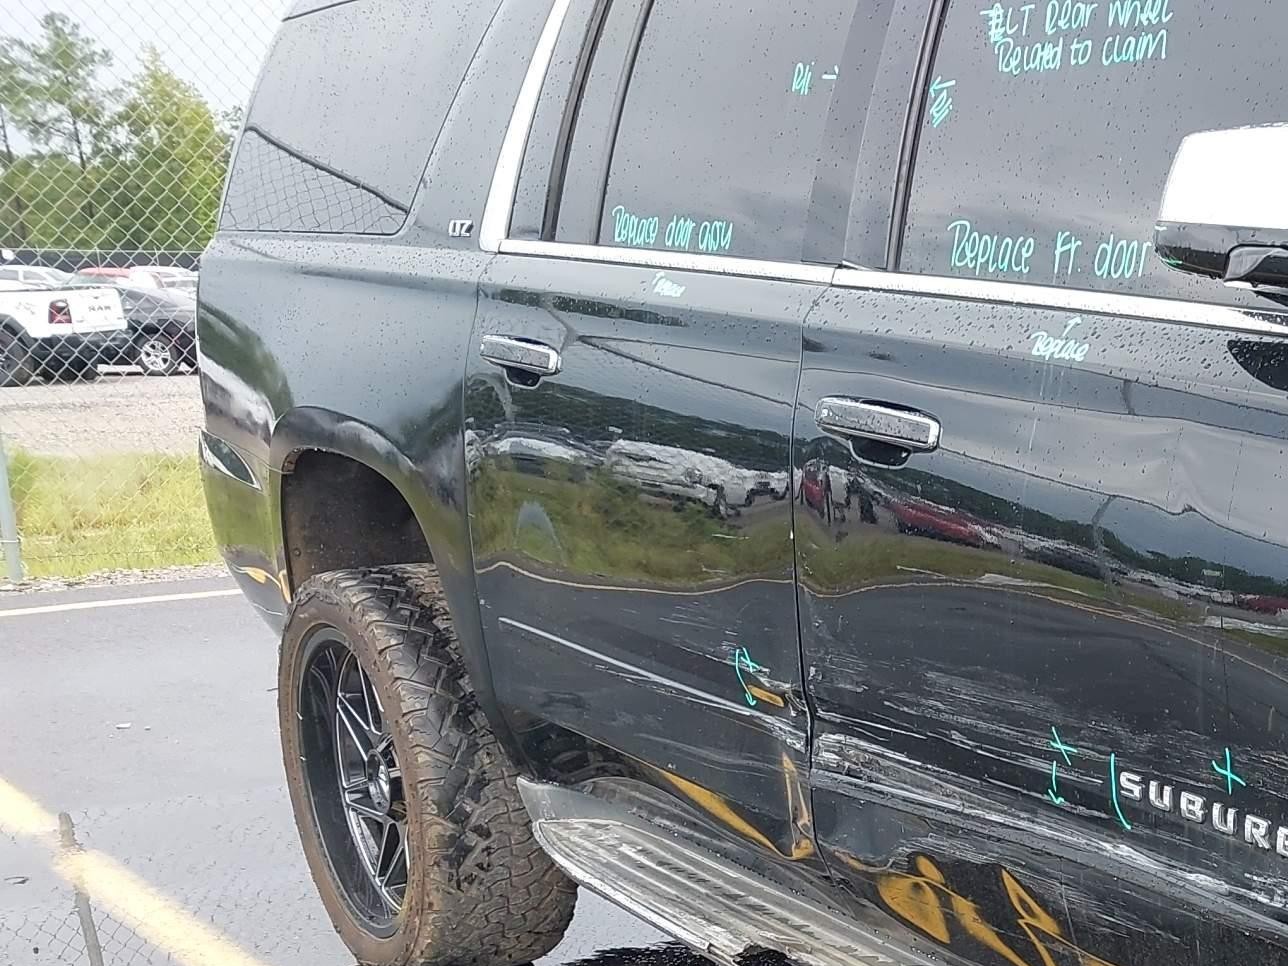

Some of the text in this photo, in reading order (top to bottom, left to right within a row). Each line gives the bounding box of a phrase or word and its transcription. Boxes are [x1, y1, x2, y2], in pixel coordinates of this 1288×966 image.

[1044, 0, 1099, 36] Rear
[994, 29, 1168, 75] Related to claim
[611, 205, 659, 247] Replace
[664, 214, 697, 251] door
[946, 220, 1035, 276] Replace
[1094, 233, 1152, 279] door
